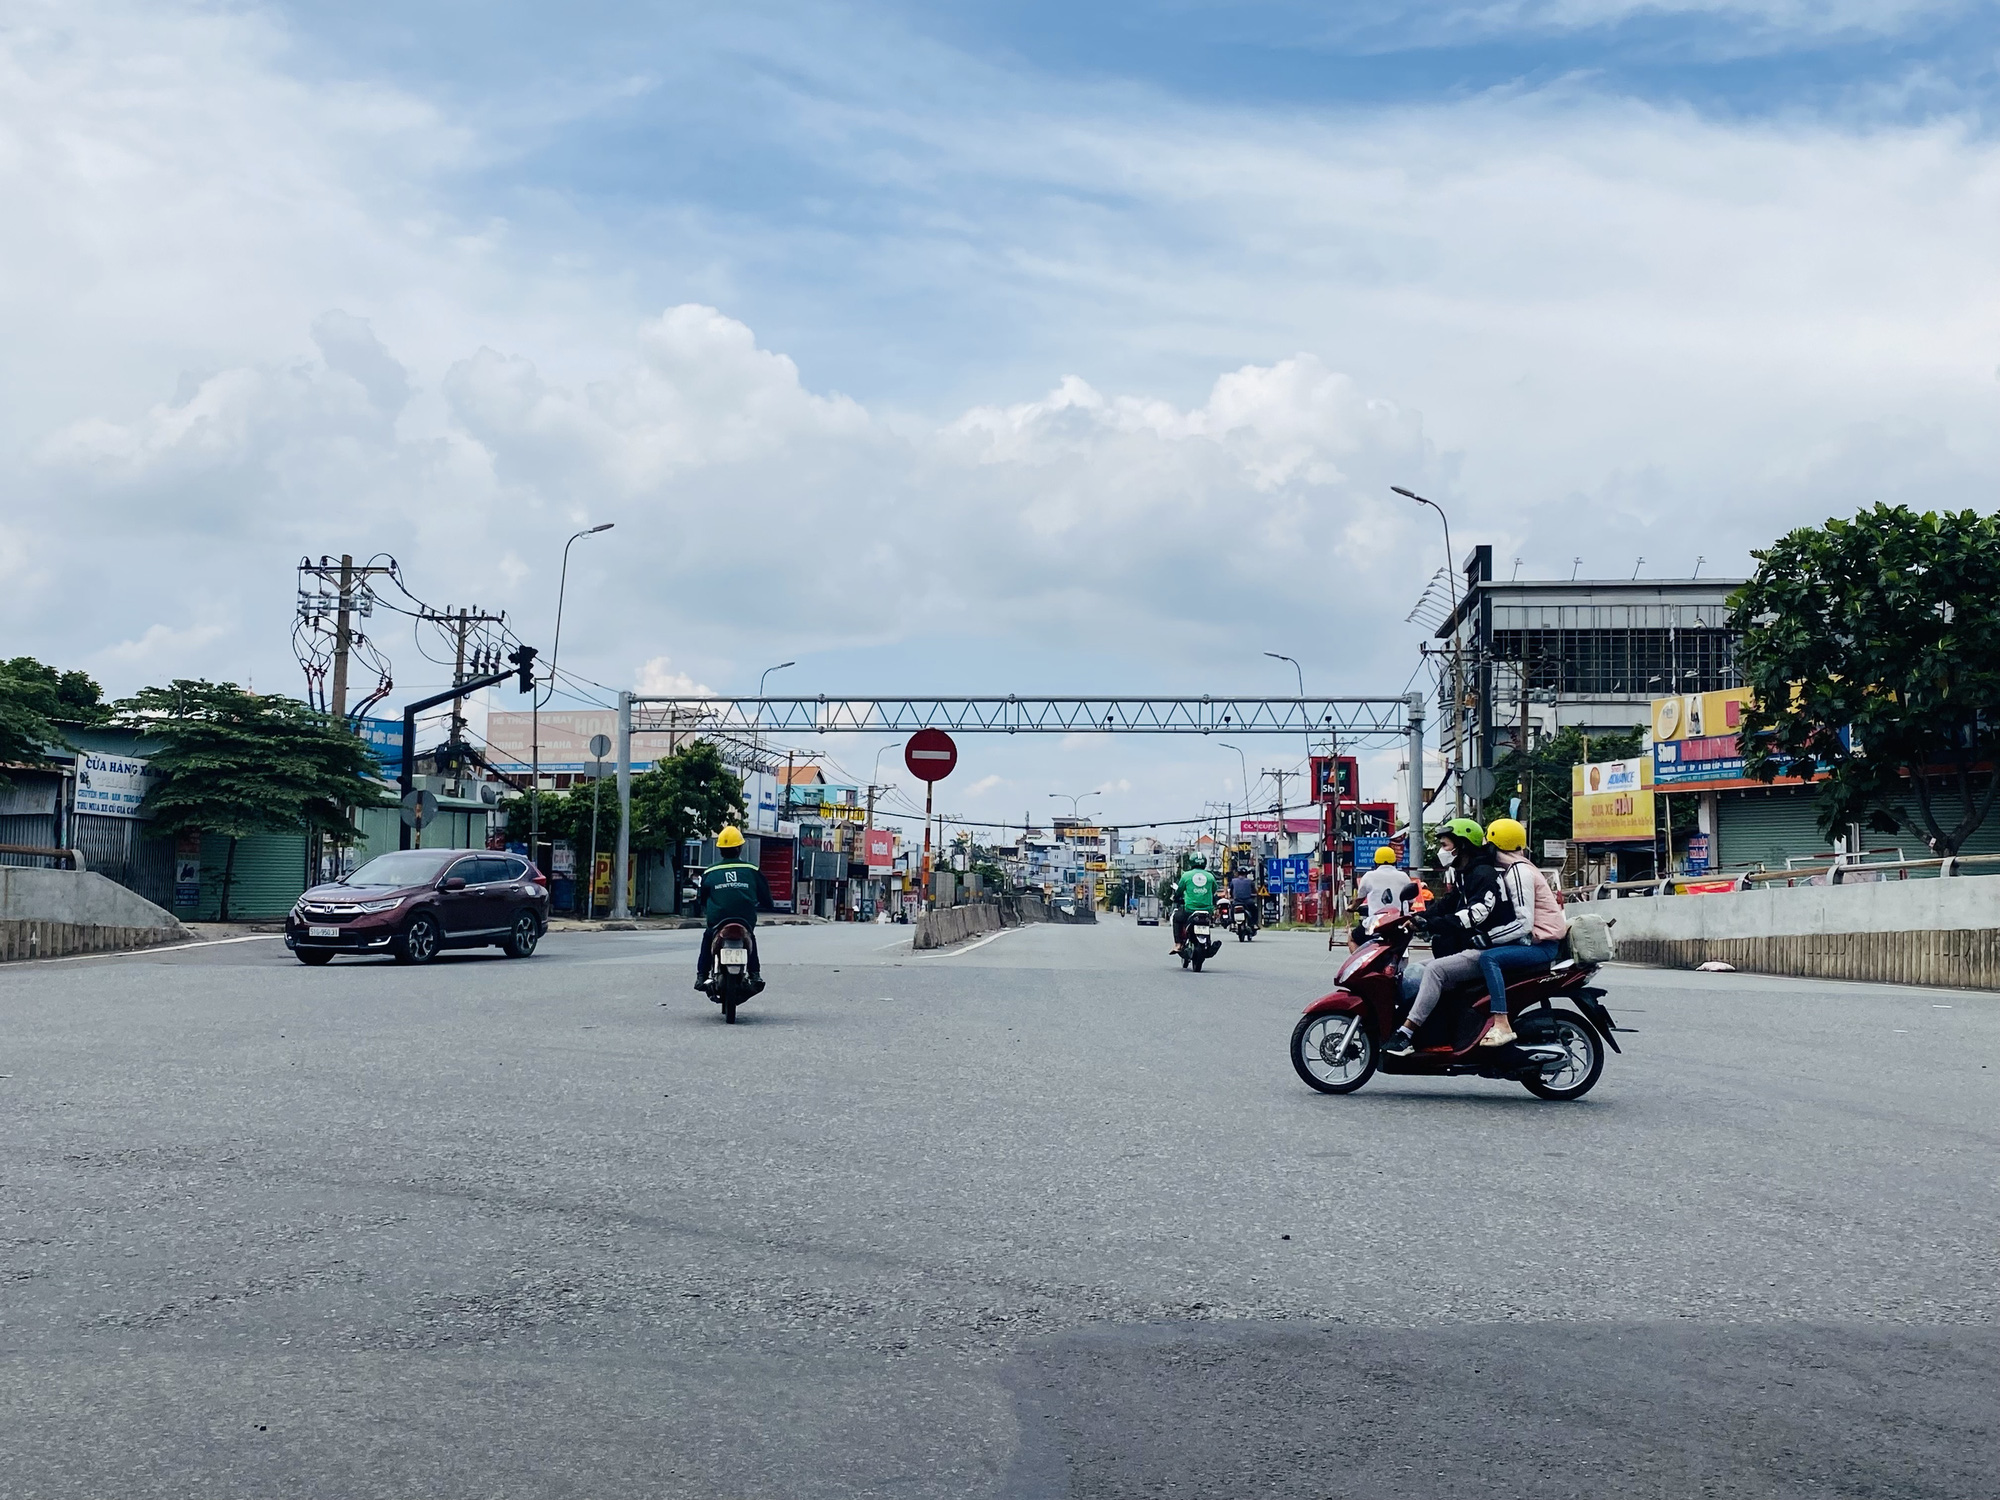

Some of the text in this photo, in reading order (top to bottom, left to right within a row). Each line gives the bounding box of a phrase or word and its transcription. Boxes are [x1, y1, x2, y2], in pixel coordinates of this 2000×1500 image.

[537, 740, 572, 749] AMAHA
[1657, 743, 1677, 763] Shop
[86, 755, 107, 772] CỬA
[109, 759, 138, 775] HÀNG
[1607, 771, 1635, 785] ADVANCE
[1605, 803, 1614, 816] XE
